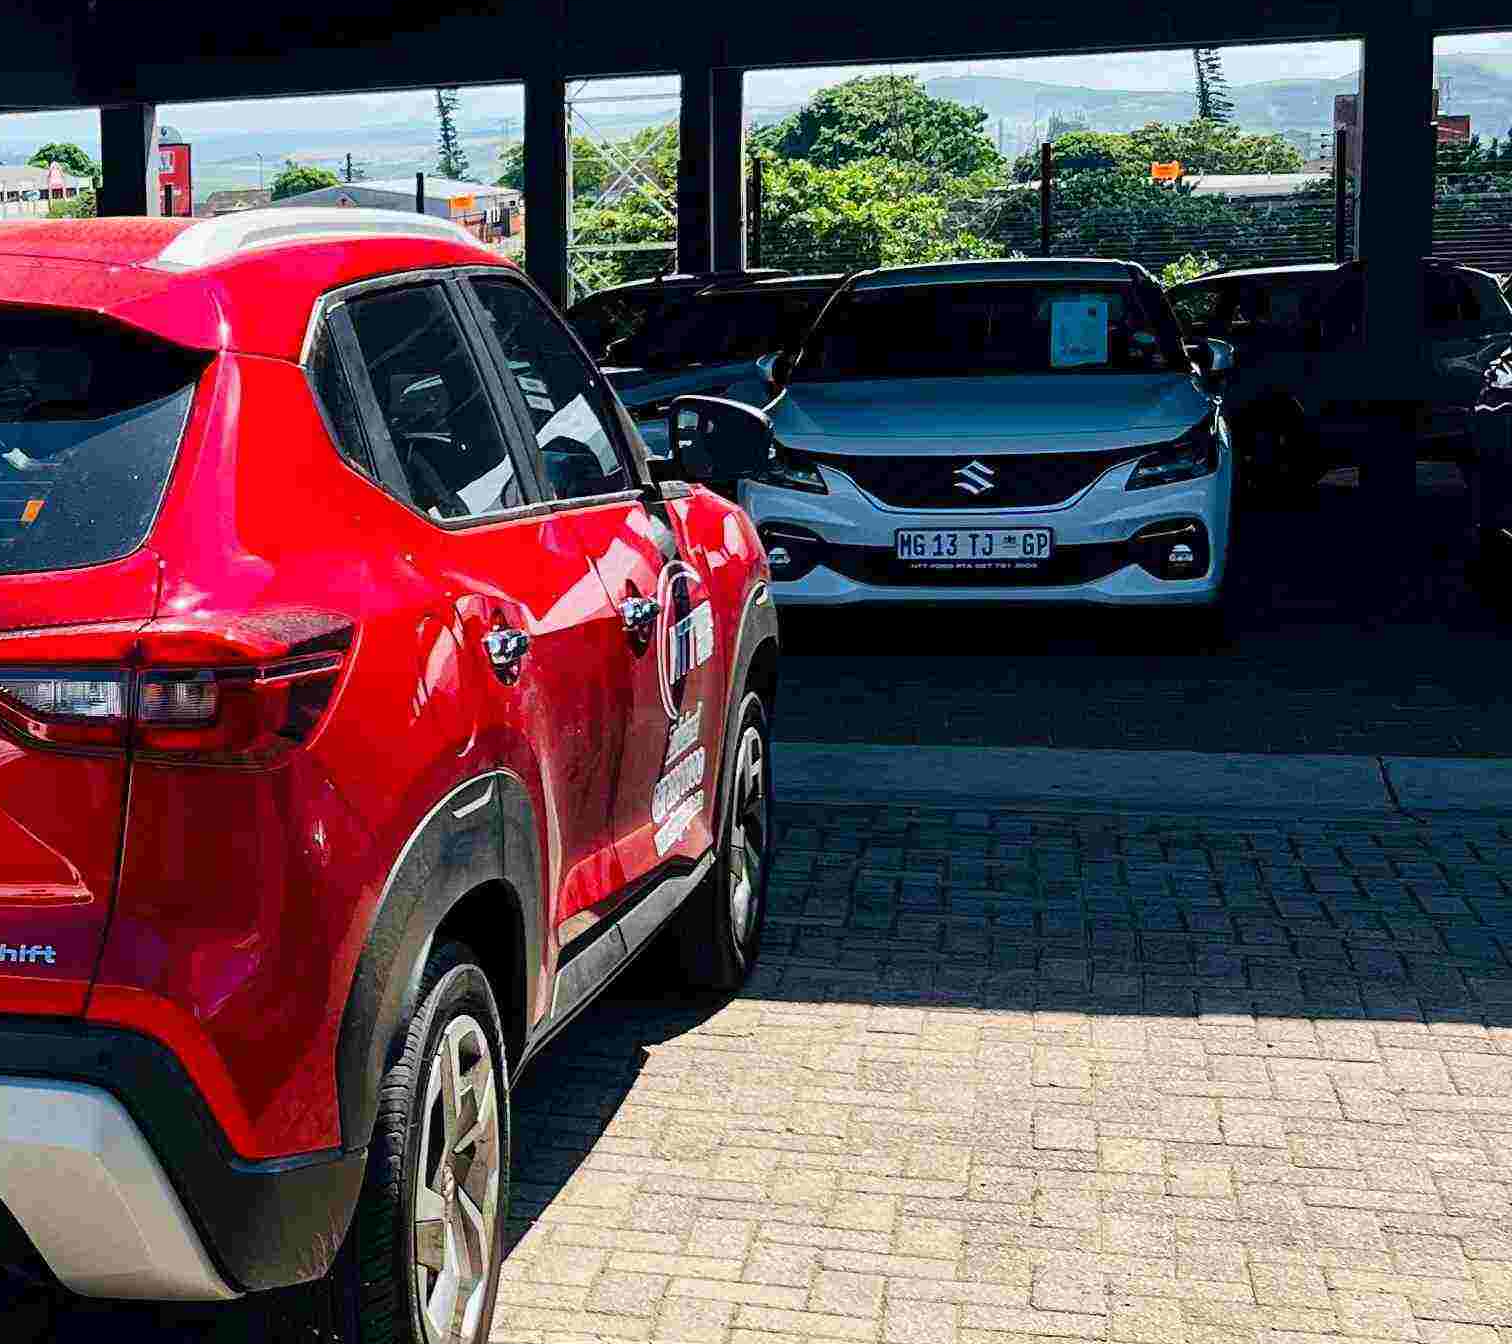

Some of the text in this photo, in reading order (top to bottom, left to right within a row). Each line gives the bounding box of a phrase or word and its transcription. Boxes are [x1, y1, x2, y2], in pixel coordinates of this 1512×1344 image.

[899, 533, 1049, 557] MG 13 TJ GP
